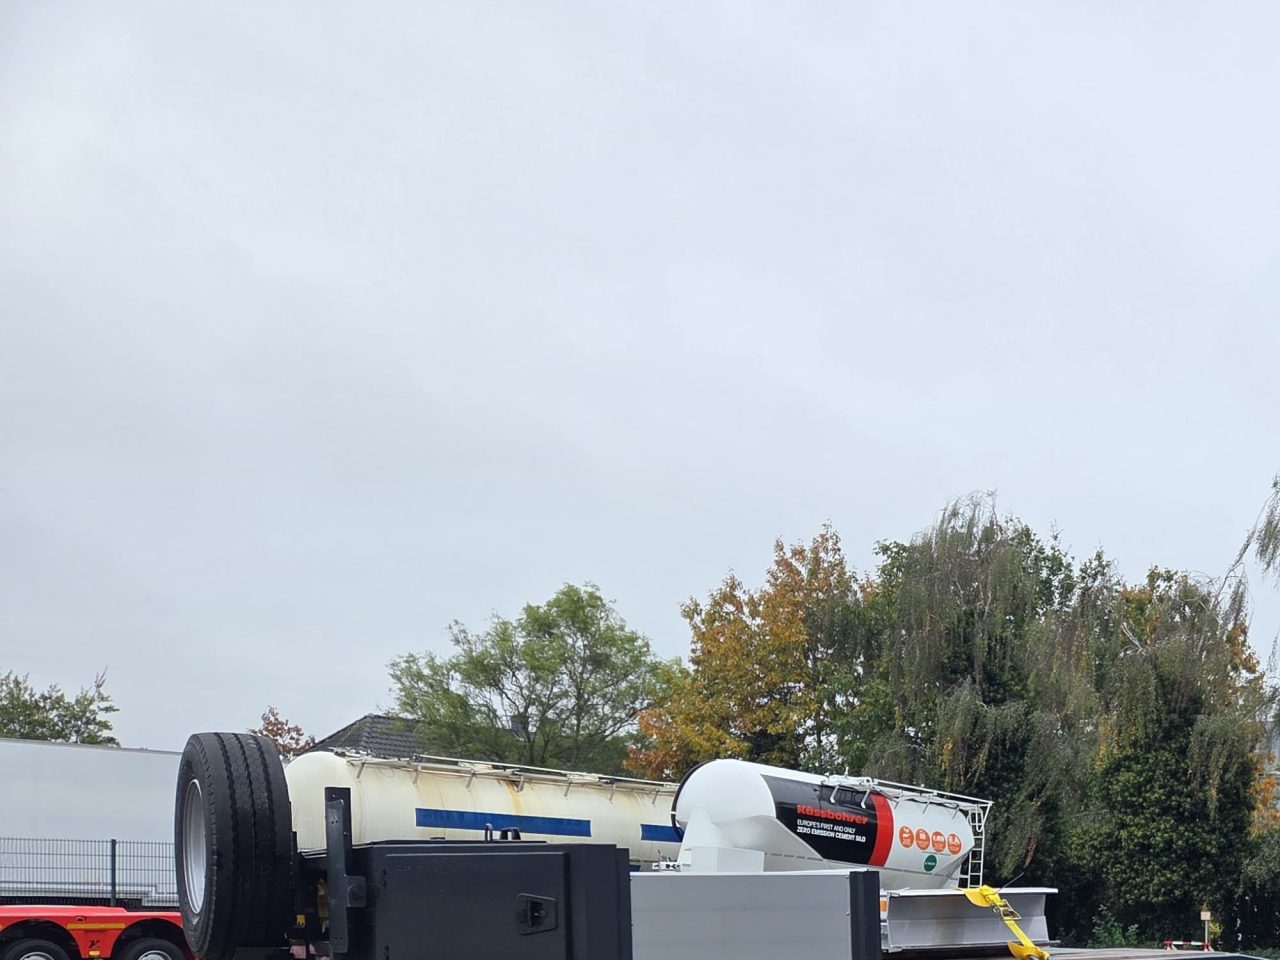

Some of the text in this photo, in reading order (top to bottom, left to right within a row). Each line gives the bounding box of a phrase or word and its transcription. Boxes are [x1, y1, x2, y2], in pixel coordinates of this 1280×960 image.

[797, 826, 866, 843] ZERO EMISSION CEMENT SILO
[820, 822, 833, 830] FIRST
[834, 824, 844, 832] AND
[844, 826, 856, 834] ONLY
